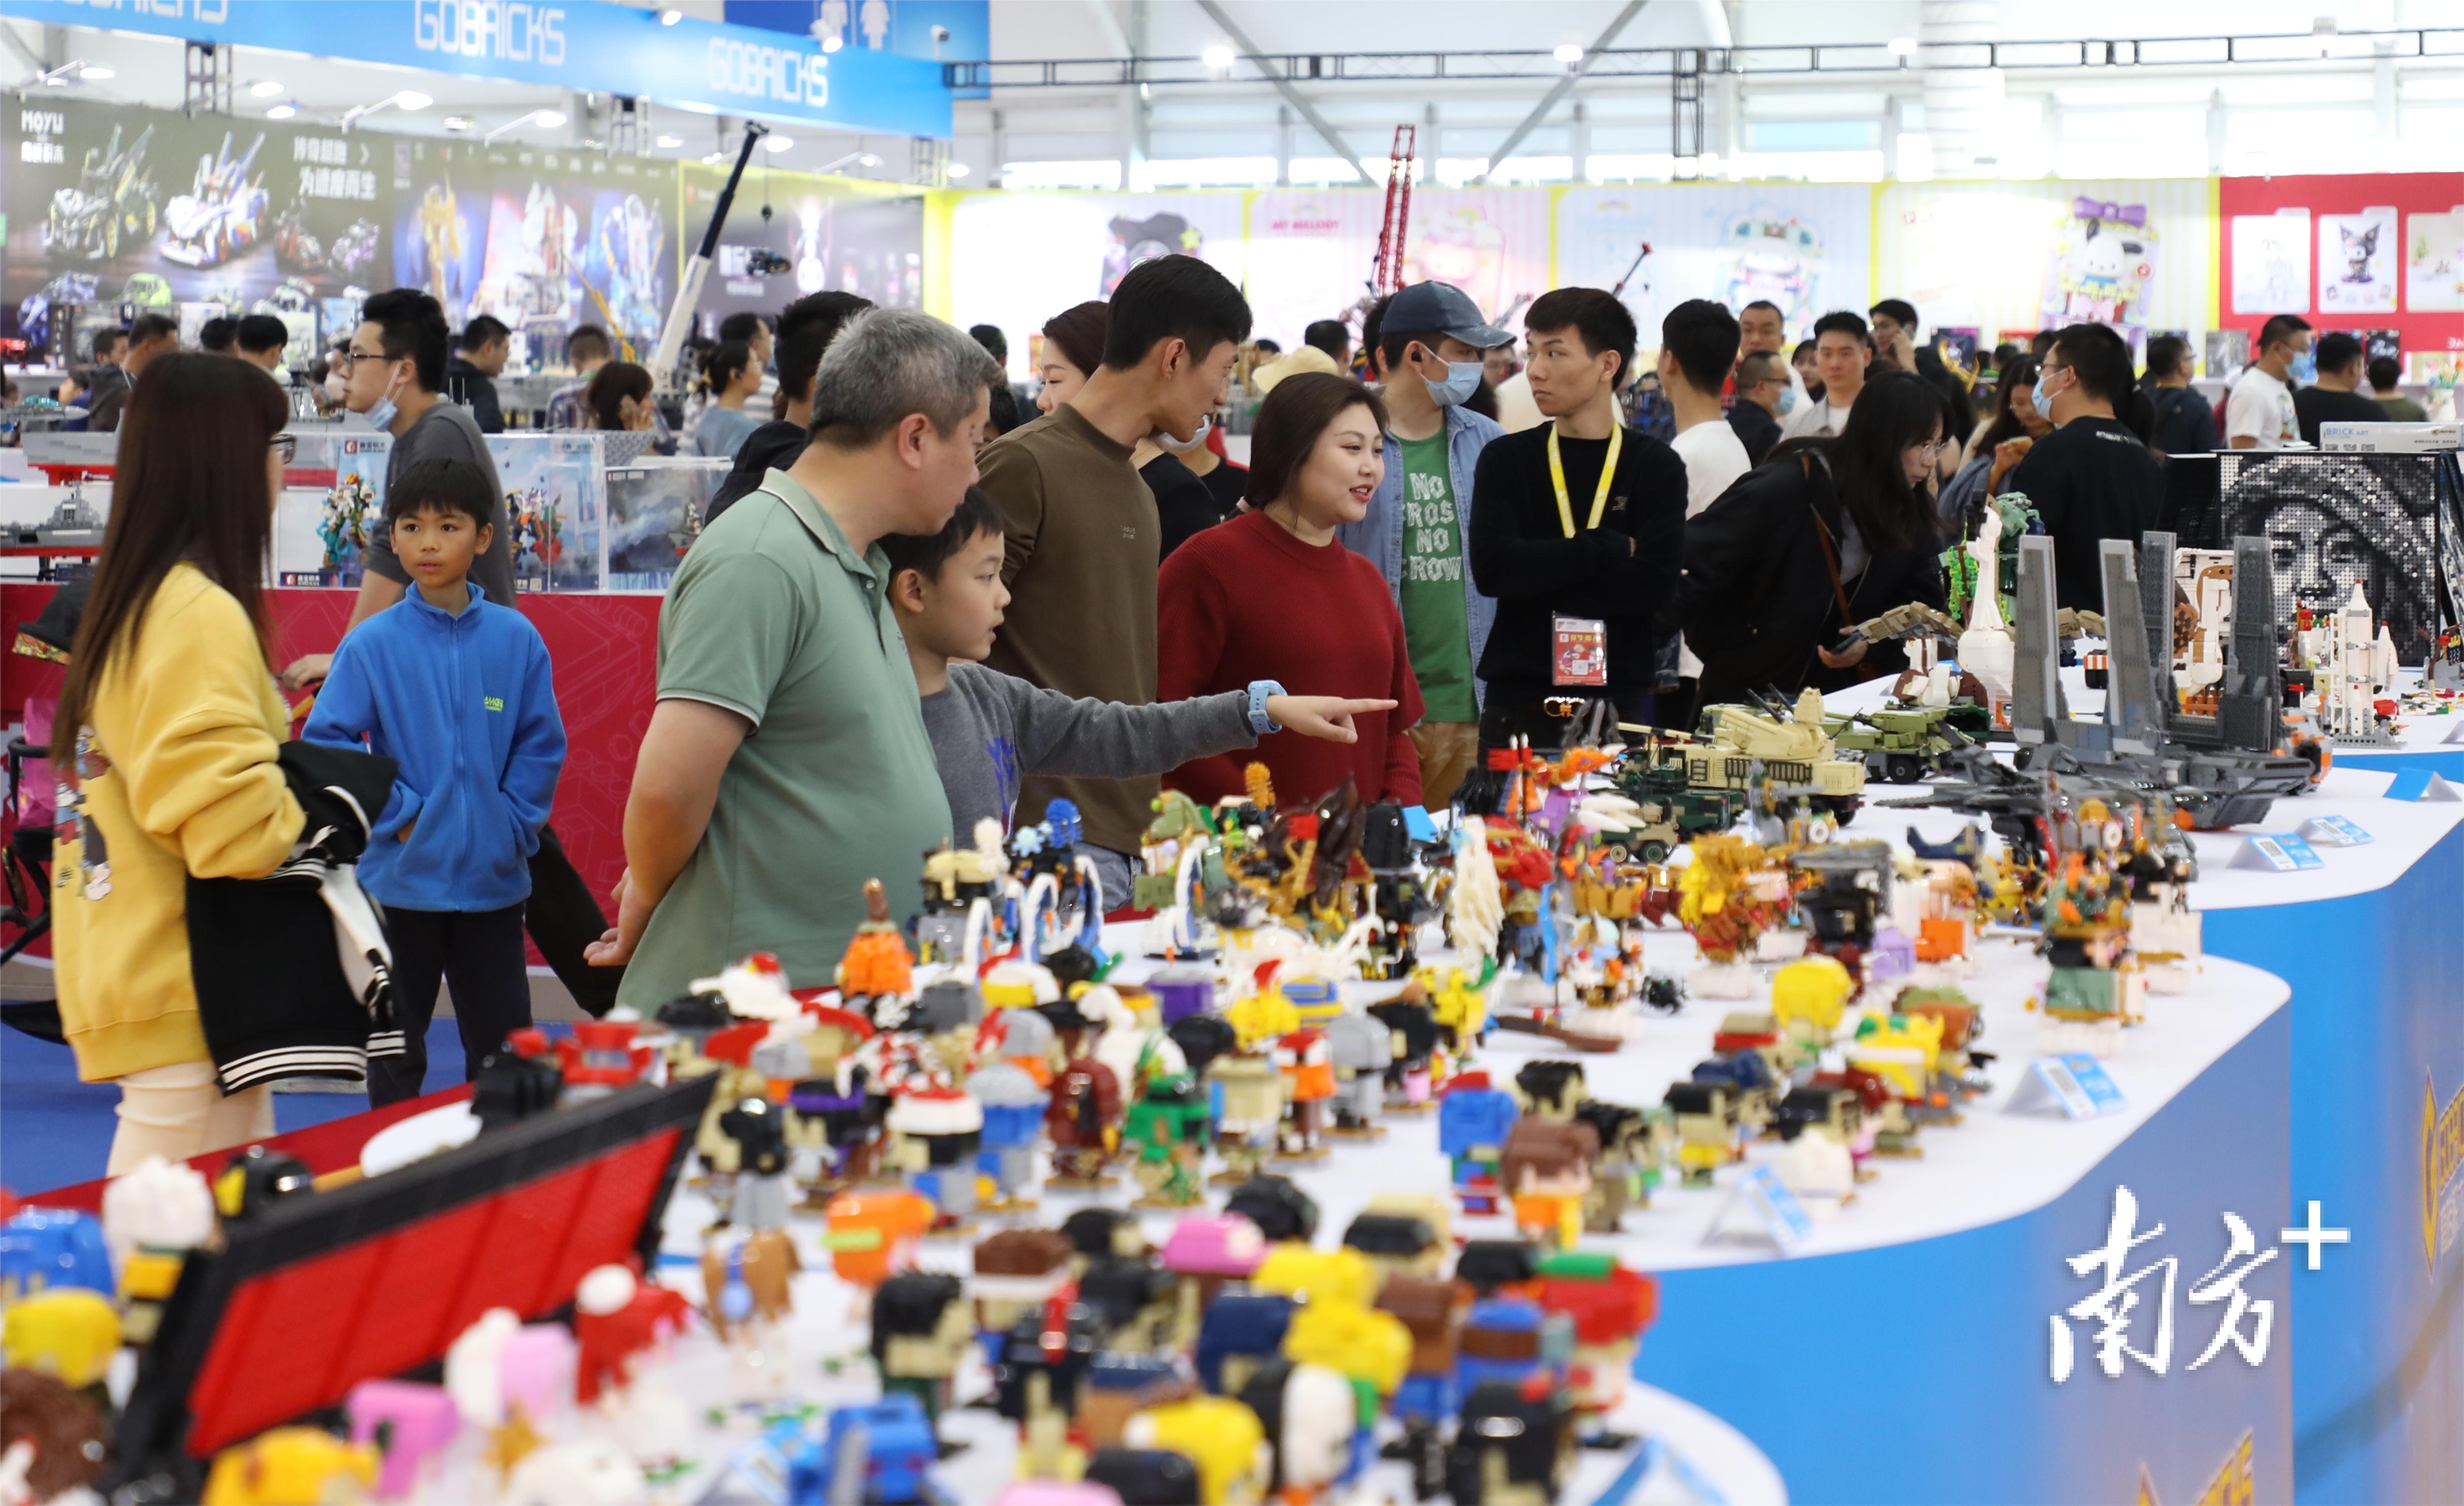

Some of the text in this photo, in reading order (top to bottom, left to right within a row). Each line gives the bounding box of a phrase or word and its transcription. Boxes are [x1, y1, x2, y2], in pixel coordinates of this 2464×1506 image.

[21, 109, 63, 134] MOYU
[1410, 472, 1446, 501] NO
[1417, 527, 1451, 553] NO
